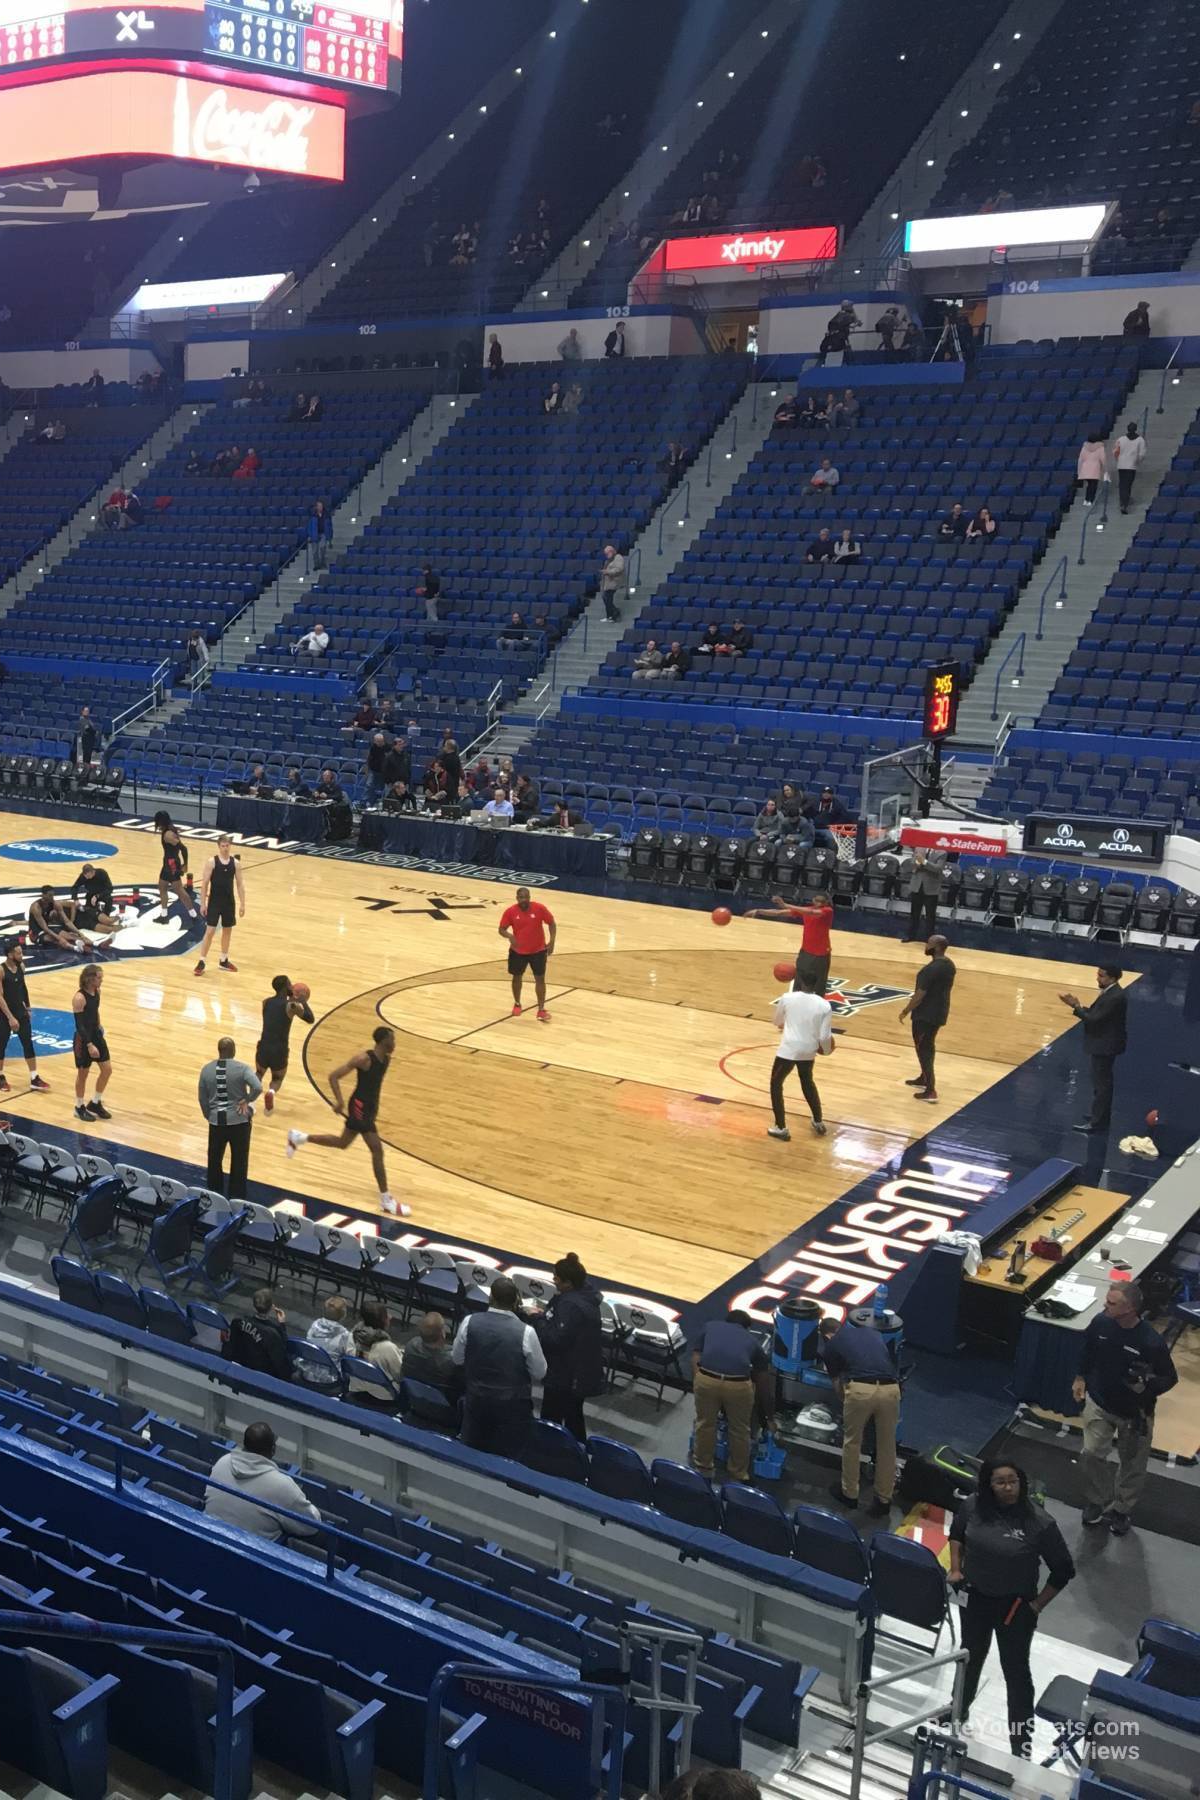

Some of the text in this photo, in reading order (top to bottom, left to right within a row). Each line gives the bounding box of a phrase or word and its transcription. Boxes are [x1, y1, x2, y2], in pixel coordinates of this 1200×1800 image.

[115, 10, 155, 42] XL
[721, 237, 785, 262] xfinity
[1008, 280, 1040, 293] 104
[606, 306, 630, 318] 103
[358, 324, 377, 335] 102
[64, 341, 80, 350] 101
[1043, 837, 1143, 853] ACURA ACURA
[728, 1155, 1012, 1326] HUSKIES
[505, 1682, 561, 1716] EXITING
[464, 1681, 582, 1740] TO ARENA FLOOR
